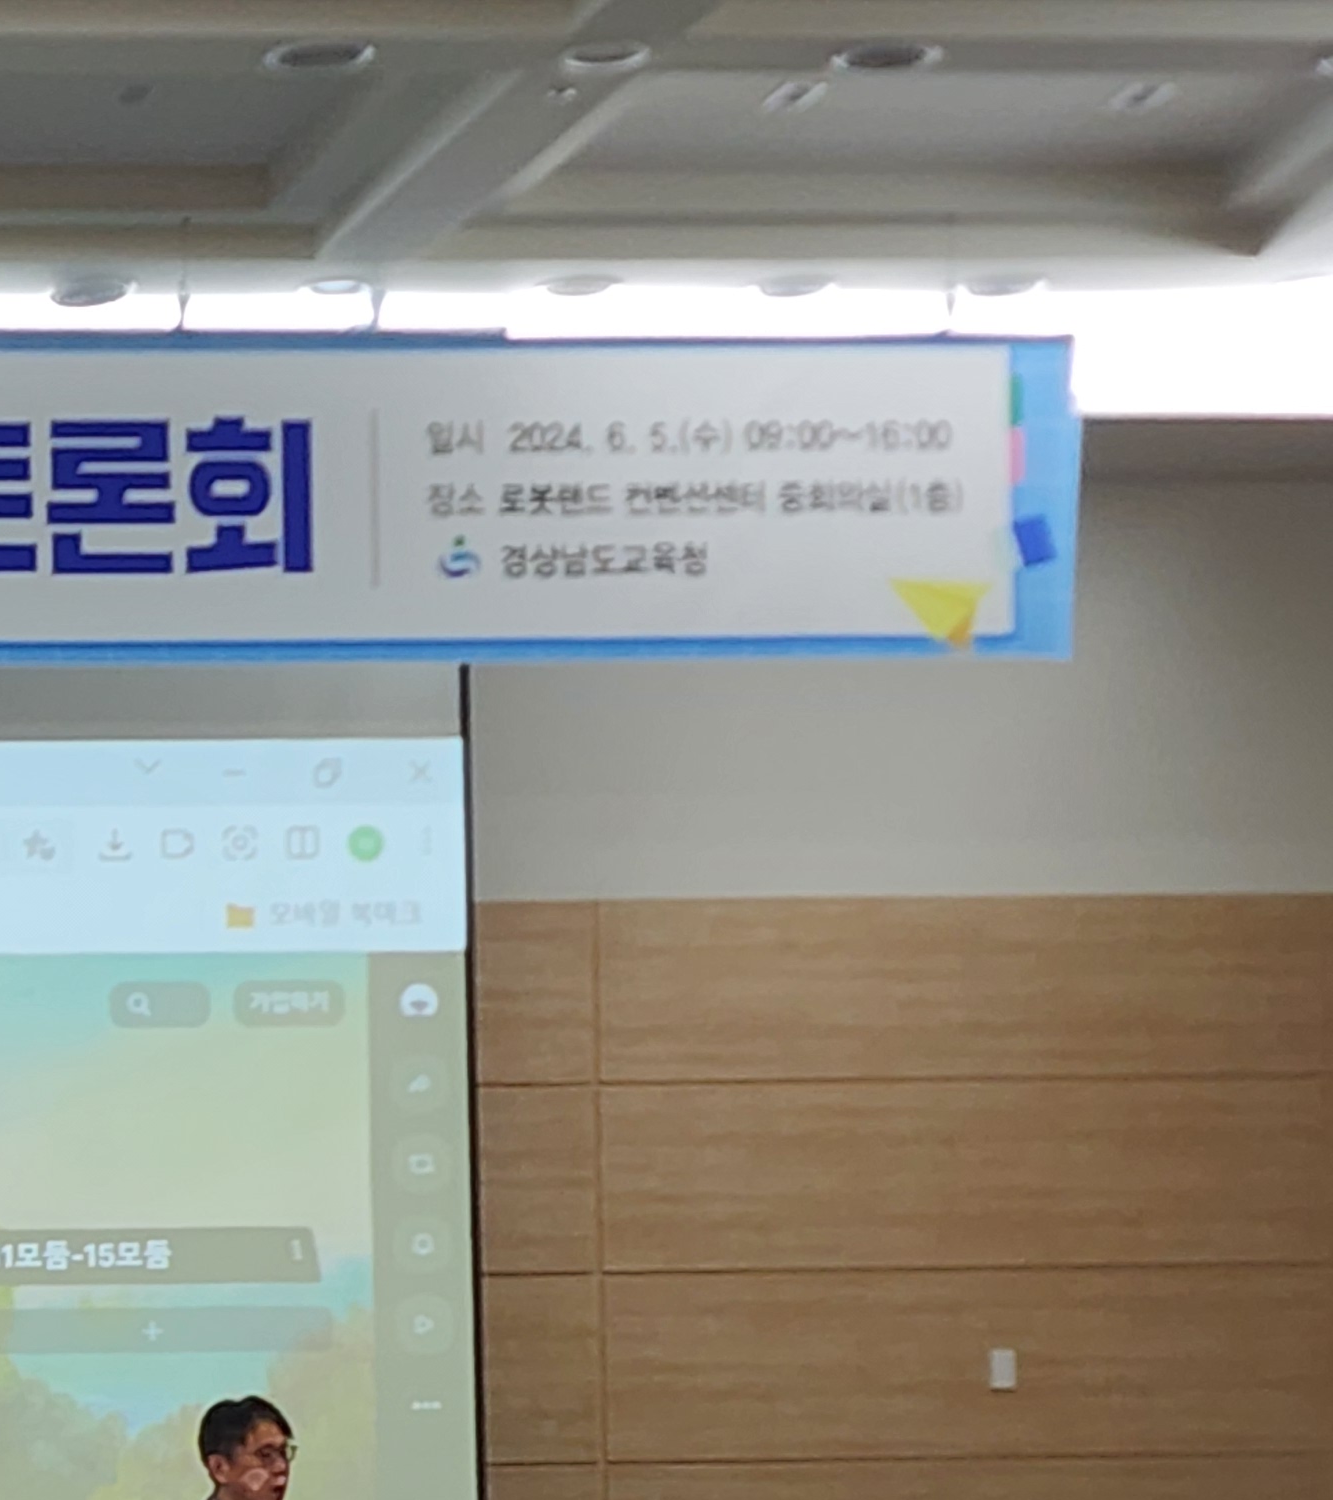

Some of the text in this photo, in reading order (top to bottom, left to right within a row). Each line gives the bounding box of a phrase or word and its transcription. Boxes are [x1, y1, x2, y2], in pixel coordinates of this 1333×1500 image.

[426, 422, 485, 455] 일시
[508, 422, 593, 453] 2024.
[607, 422, 635, 453] 6.
[745, 419, 951, 452] 09:00~16:00
[428, 483, 485, 517] 장소
[498, 483, 611, 517] 로봇랜드
[625, 482, 766, 517] 컨벤션센터
[502, 544, 707, 577] 경상남도교육청
